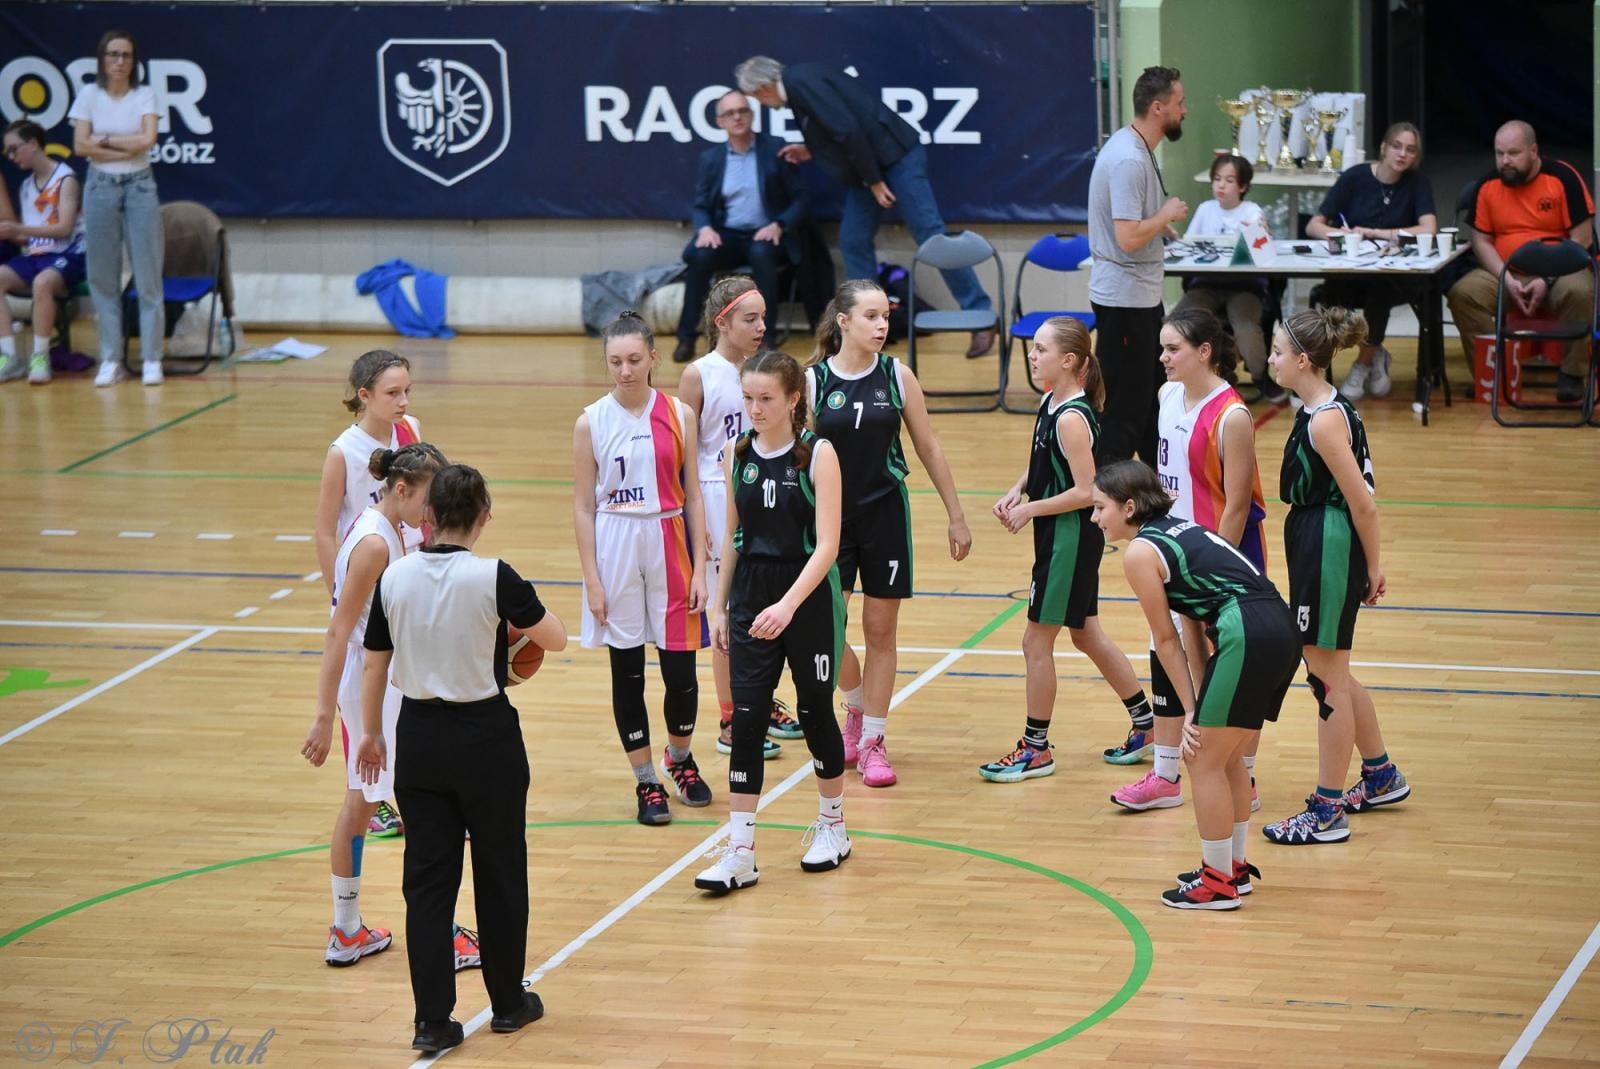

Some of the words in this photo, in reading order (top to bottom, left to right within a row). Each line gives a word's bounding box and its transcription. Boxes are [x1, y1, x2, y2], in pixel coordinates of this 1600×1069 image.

[724, 411, 742, 440] 27
[853, 401, 864, 429] 7
[762, 478, 776, 509] 10
[888, 560, 899, 586] 7
[1297, 605, 1310, 632] 13
[814, 654, 830, 682] 10
[1154, 695, 1167, 707] NBA
[734, 771, 747, 783] NBA
